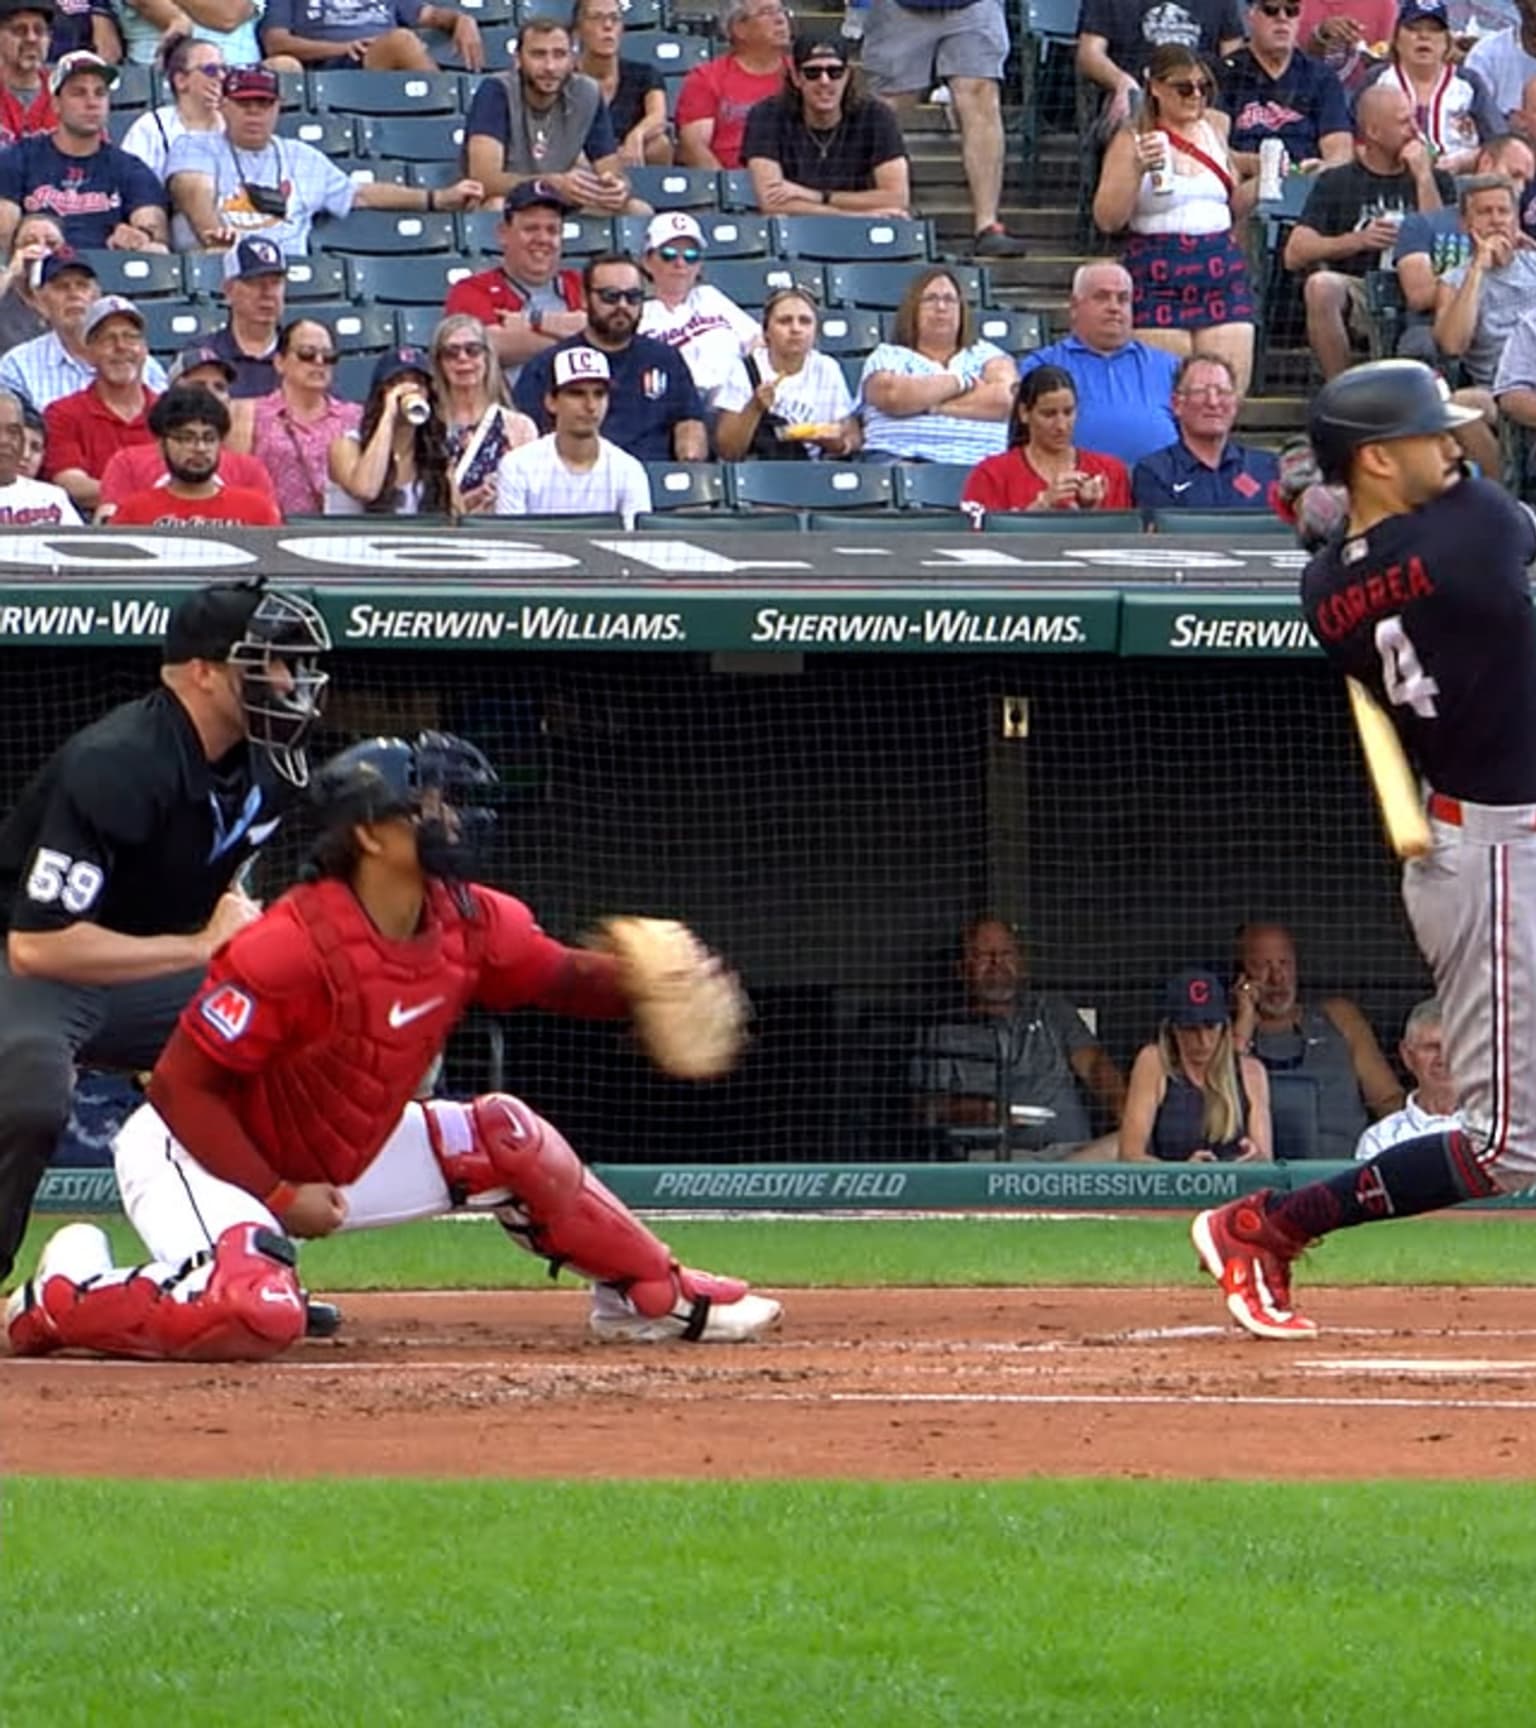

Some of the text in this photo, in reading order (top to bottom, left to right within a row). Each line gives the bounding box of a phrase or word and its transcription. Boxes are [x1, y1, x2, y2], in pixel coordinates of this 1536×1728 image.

[1316, 555, 1435, 642] CORREA
[1376, 615, 1439, 718] 4
[28, 848, 104, 912] 59
[1189, 980, 1209, 1003] C
[653, 1173, 908, 1198] PROGRESSIVE FIELD
[988, 1173, 1238, 1199] PROGRESSIVE.COM
